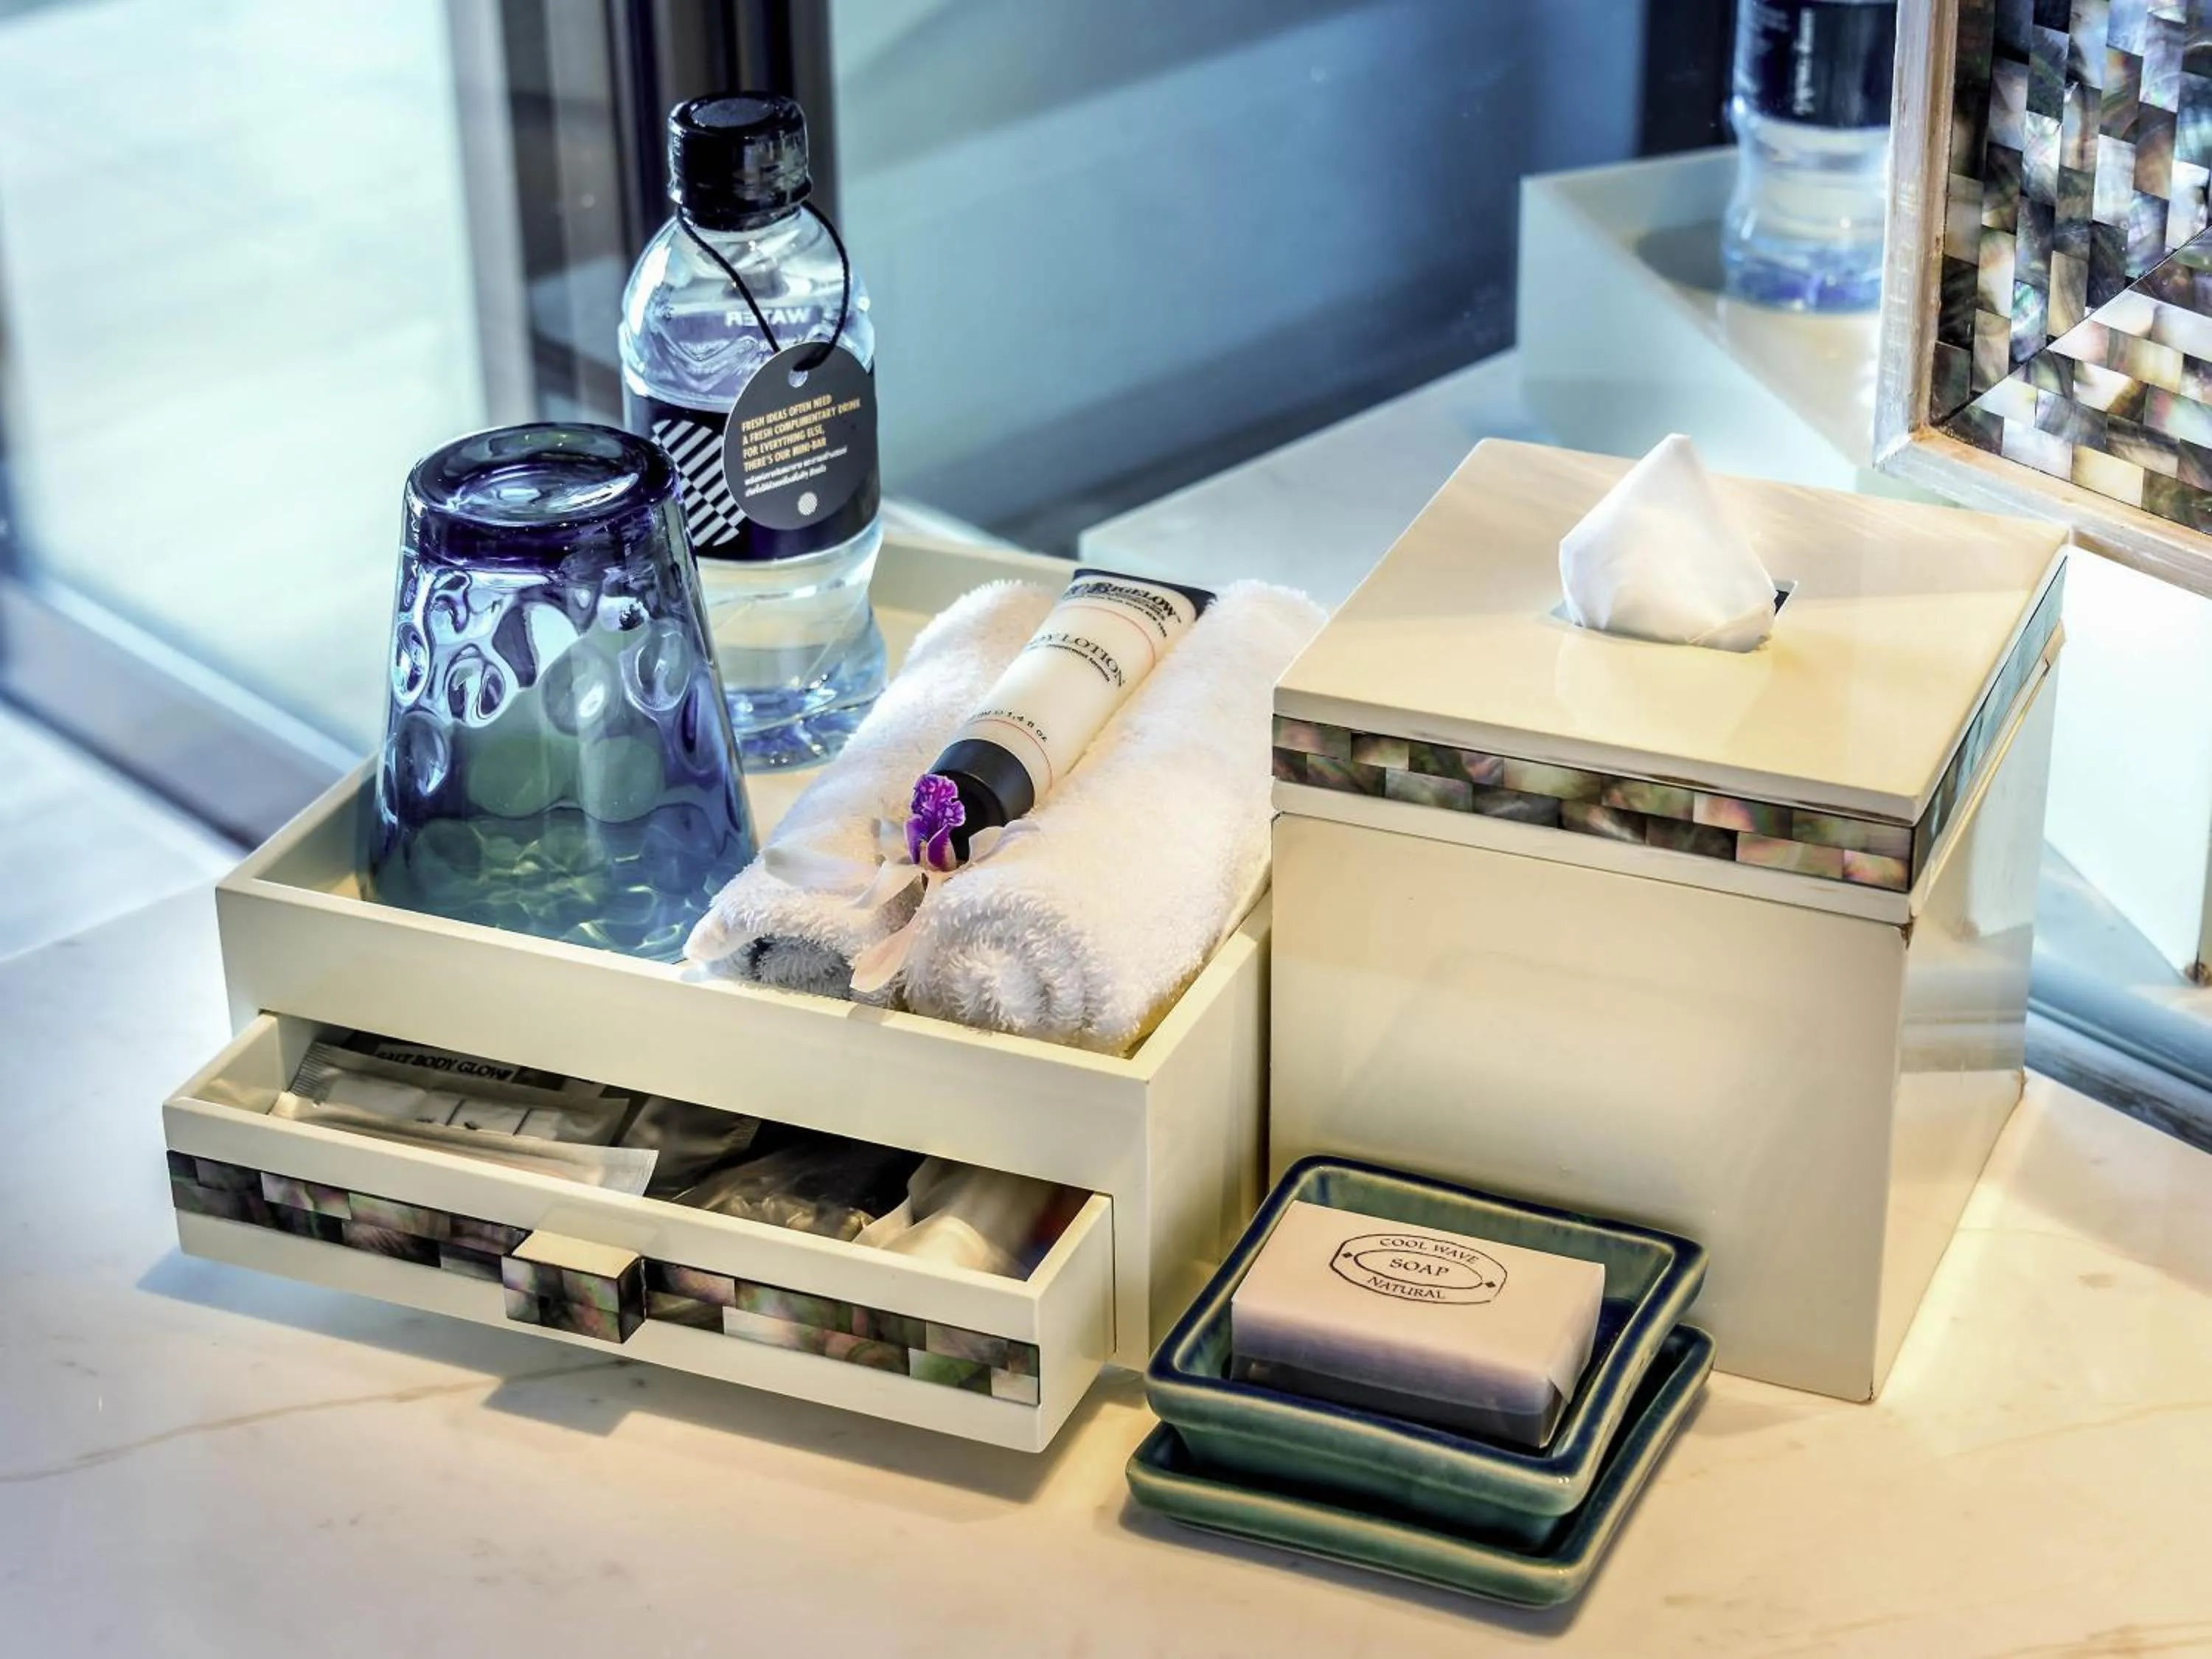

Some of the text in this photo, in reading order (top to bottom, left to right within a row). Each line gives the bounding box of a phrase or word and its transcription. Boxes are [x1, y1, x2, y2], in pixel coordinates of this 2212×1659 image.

[742, 394, 832, 432] FRESH IDEAS OFTEN NEED
[742, 397, 862, 446] A FRESH COMPLIMENTARY DRINK
[742, 447, 759, 459] FOR
[759, 430, 806, 454] EVERYTHING
[743, 456, 773, 473] THERE'S
[774, 448, 791, 462] OUR
[1061, 633, 1125, 687] LOTION
[411, 1054, 458, 1072] BODY
[1379, 1238, 1481, 1265] COOL WAVE
[1388, 1258, 1450, 1277] SOAP
[1368, 1276, 1447, 1300] NATURAL
